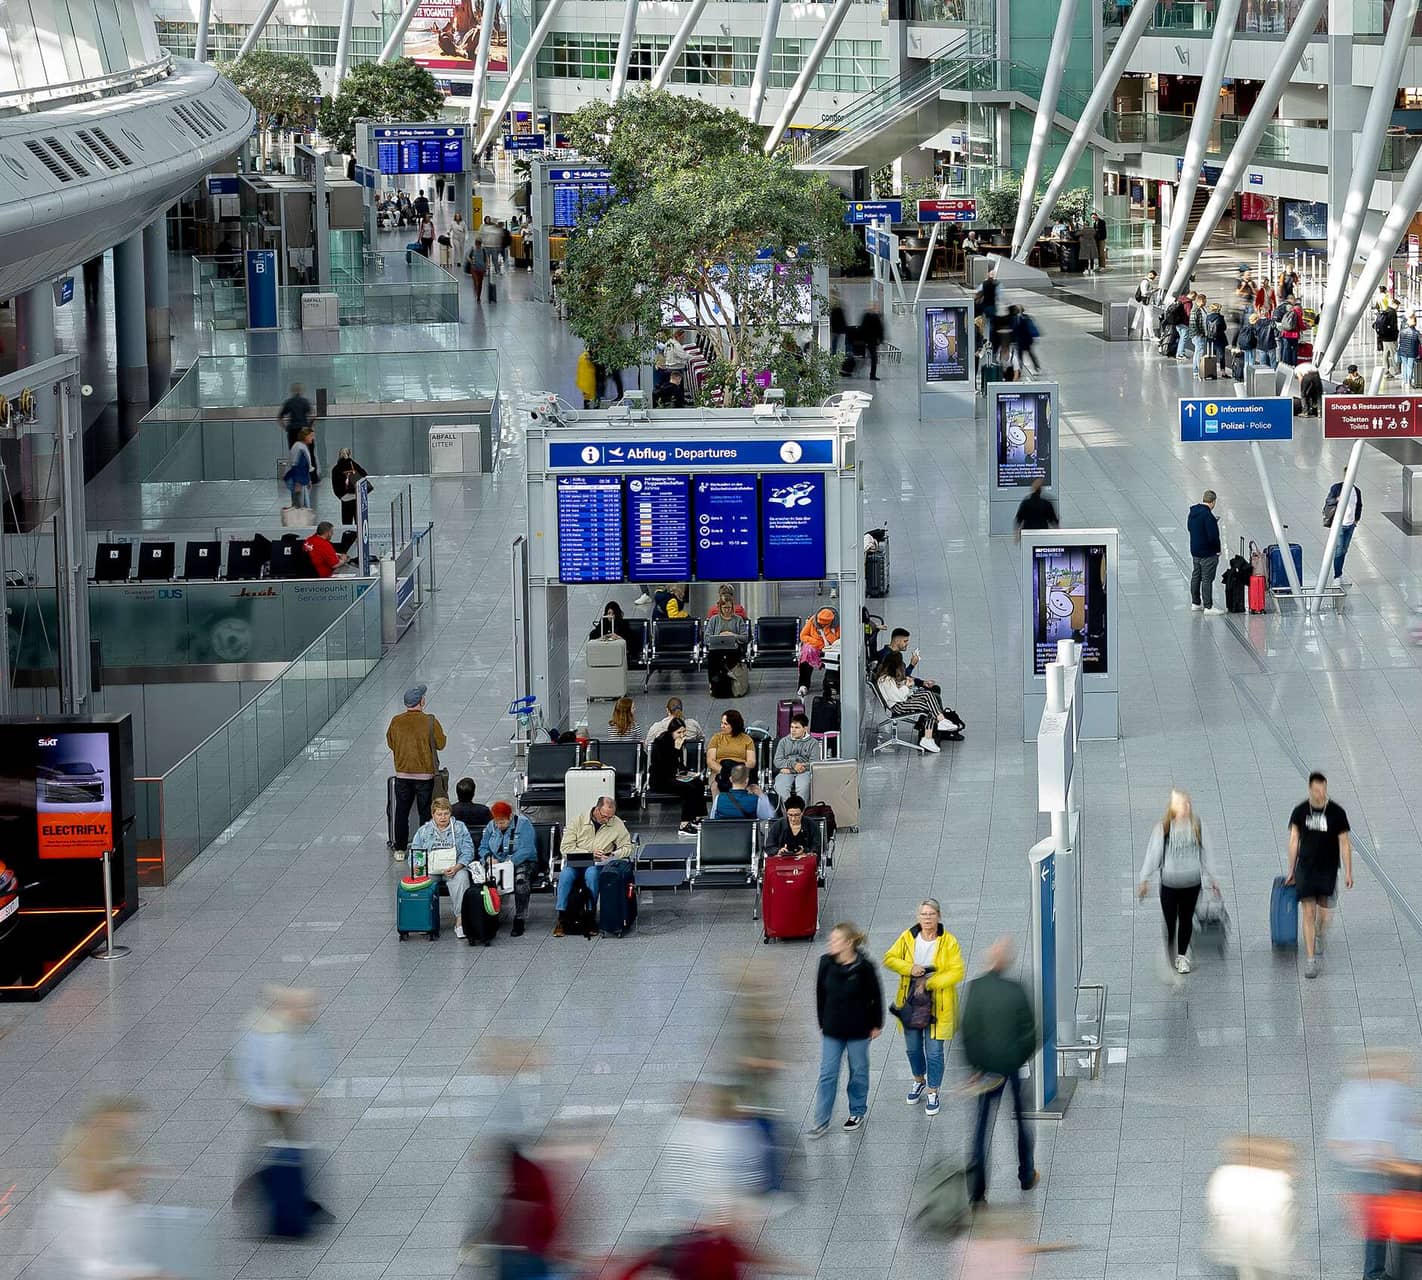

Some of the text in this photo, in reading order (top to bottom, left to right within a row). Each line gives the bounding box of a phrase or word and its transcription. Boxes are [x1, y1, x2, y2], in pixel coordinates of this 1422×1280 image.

[255, 263, 265, 274] B
[1220, 404, 1264, 413] Information
[1330, 403, 1351, 411] Shops
[1358, 402, 1396, 410] Restaurants
[1220, 421, 1273, 430] Polizei Police
[627, 447, 738, 461] Abflug Departures
[158, 589, 183, 599] DUS
[294, 584, 348, 594] Servicepunkt
[38, 738, 59, 746] SIXT
[42, 825, 109, 836] ELECTRIFLY.
